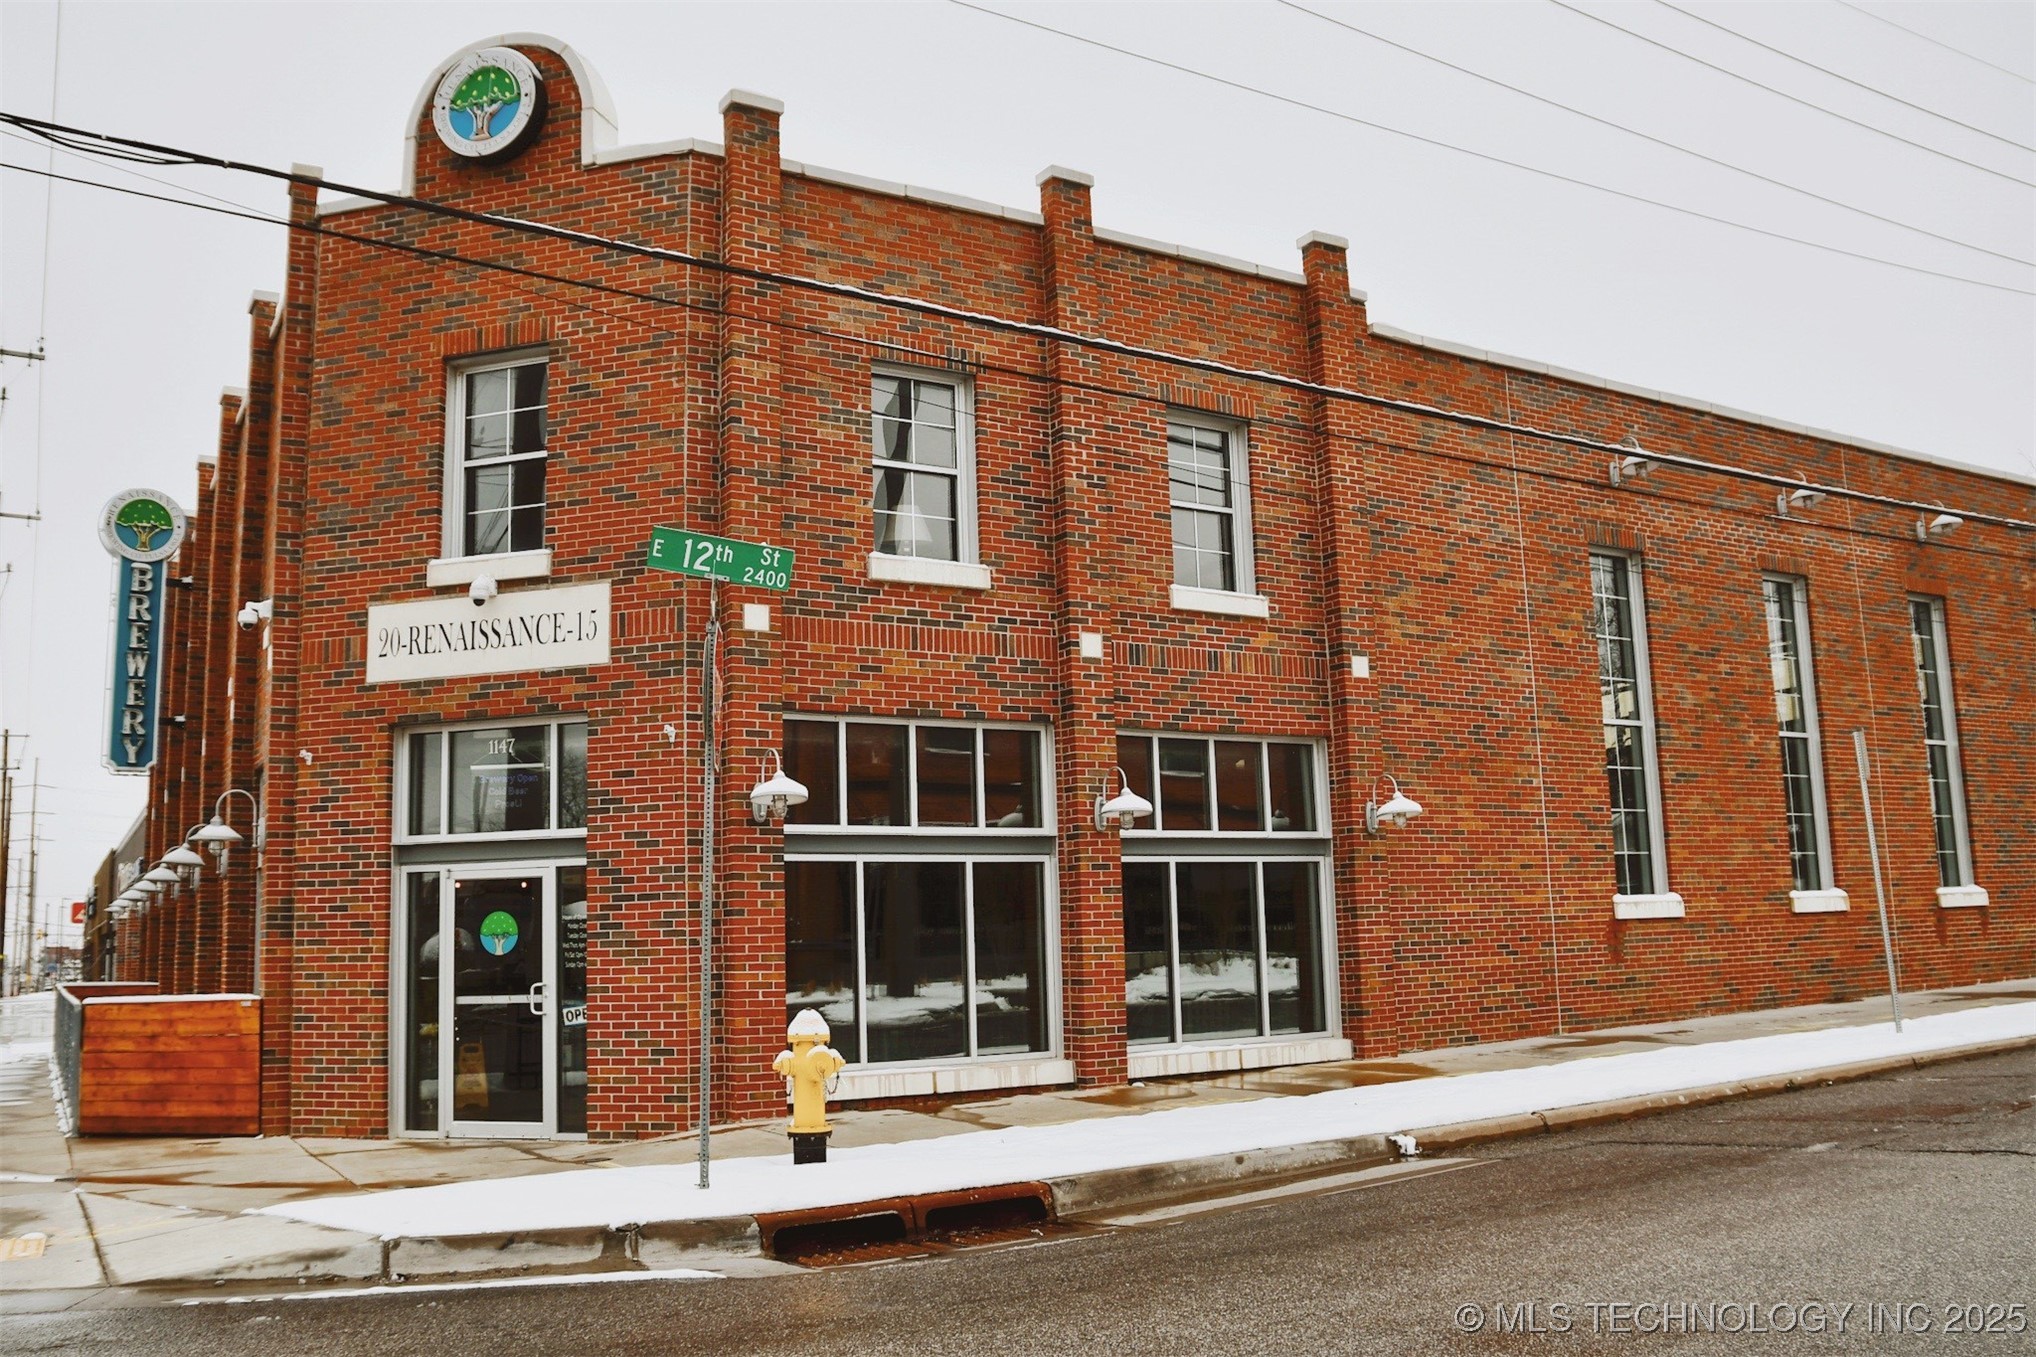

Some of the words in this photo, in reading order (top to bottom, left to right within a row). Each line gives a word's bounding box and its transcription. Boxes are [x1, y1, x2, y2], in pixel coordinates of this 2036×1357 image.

[652, 539, 665, 557] E
[683, 538, 734, 572] 12th
[760, 548, 781, 567] St
[743, 567, 787, 588] 2400
[378, 609, 598, 658] 20-RENAISSANCE-15
[121, 562, 154, 764] BREWERY
[488, 738, 515, 755] 1147
